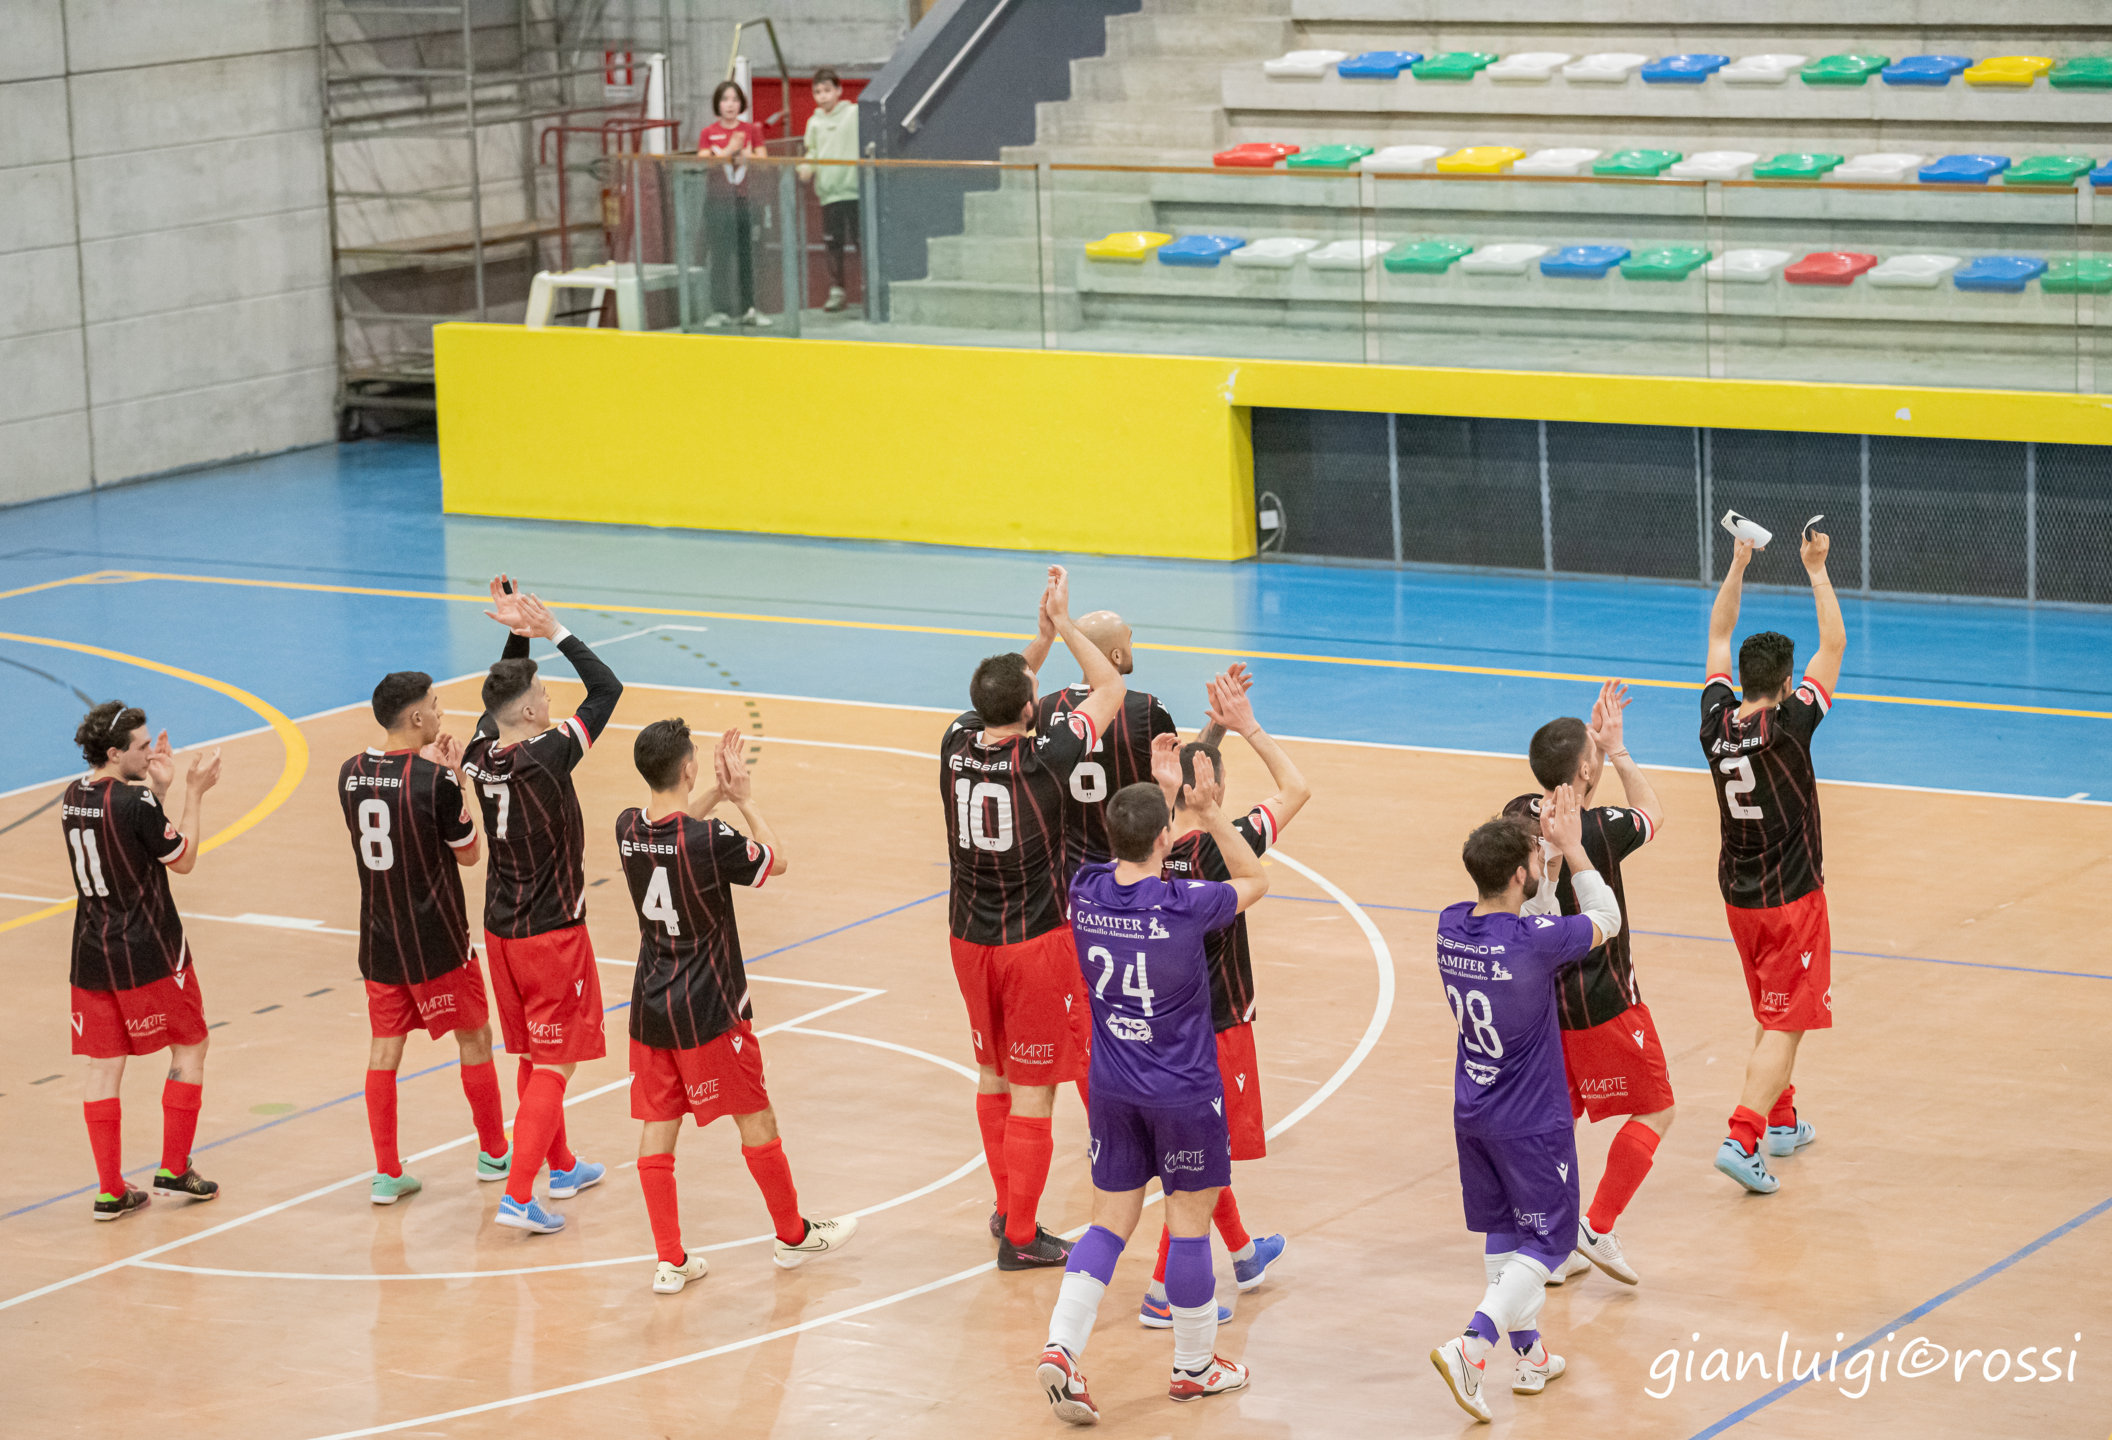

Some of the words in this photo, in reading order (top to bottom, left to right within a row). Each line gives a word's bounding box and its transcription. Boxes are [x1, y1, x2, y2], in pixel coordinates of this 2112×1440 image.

[1721, 736, 1763, 753] ESEBI
[964, 758, 1013, 772] ESSEBI
[359, 776, 403, 788] ESSEBI
[1719, 755, 1764, 820] 2
[68, 805, 104, 818] ESSEBI
[483, 782, 510, 840] 7
[955, 778, 1013, 853] 10
[358, 798, 394, 871] 8
[632, 842, 678, 855] ESSEBI
[69, 828, 110, 897] 11
[1162, 860, 1193, 872] SEBI
[641, 866, 681, 936] 4
[1077, 910, 1143, 931] GAMIFER
[1087, 945, 1155, 1017] 24
[1446, 984, 1504, 1059] 28
[1009, 1041, 1055, 1058] MARTE
[1579, 1076, 1628, 1092] MARTE
[1164, 1149, 1205, 1167] MARTE
